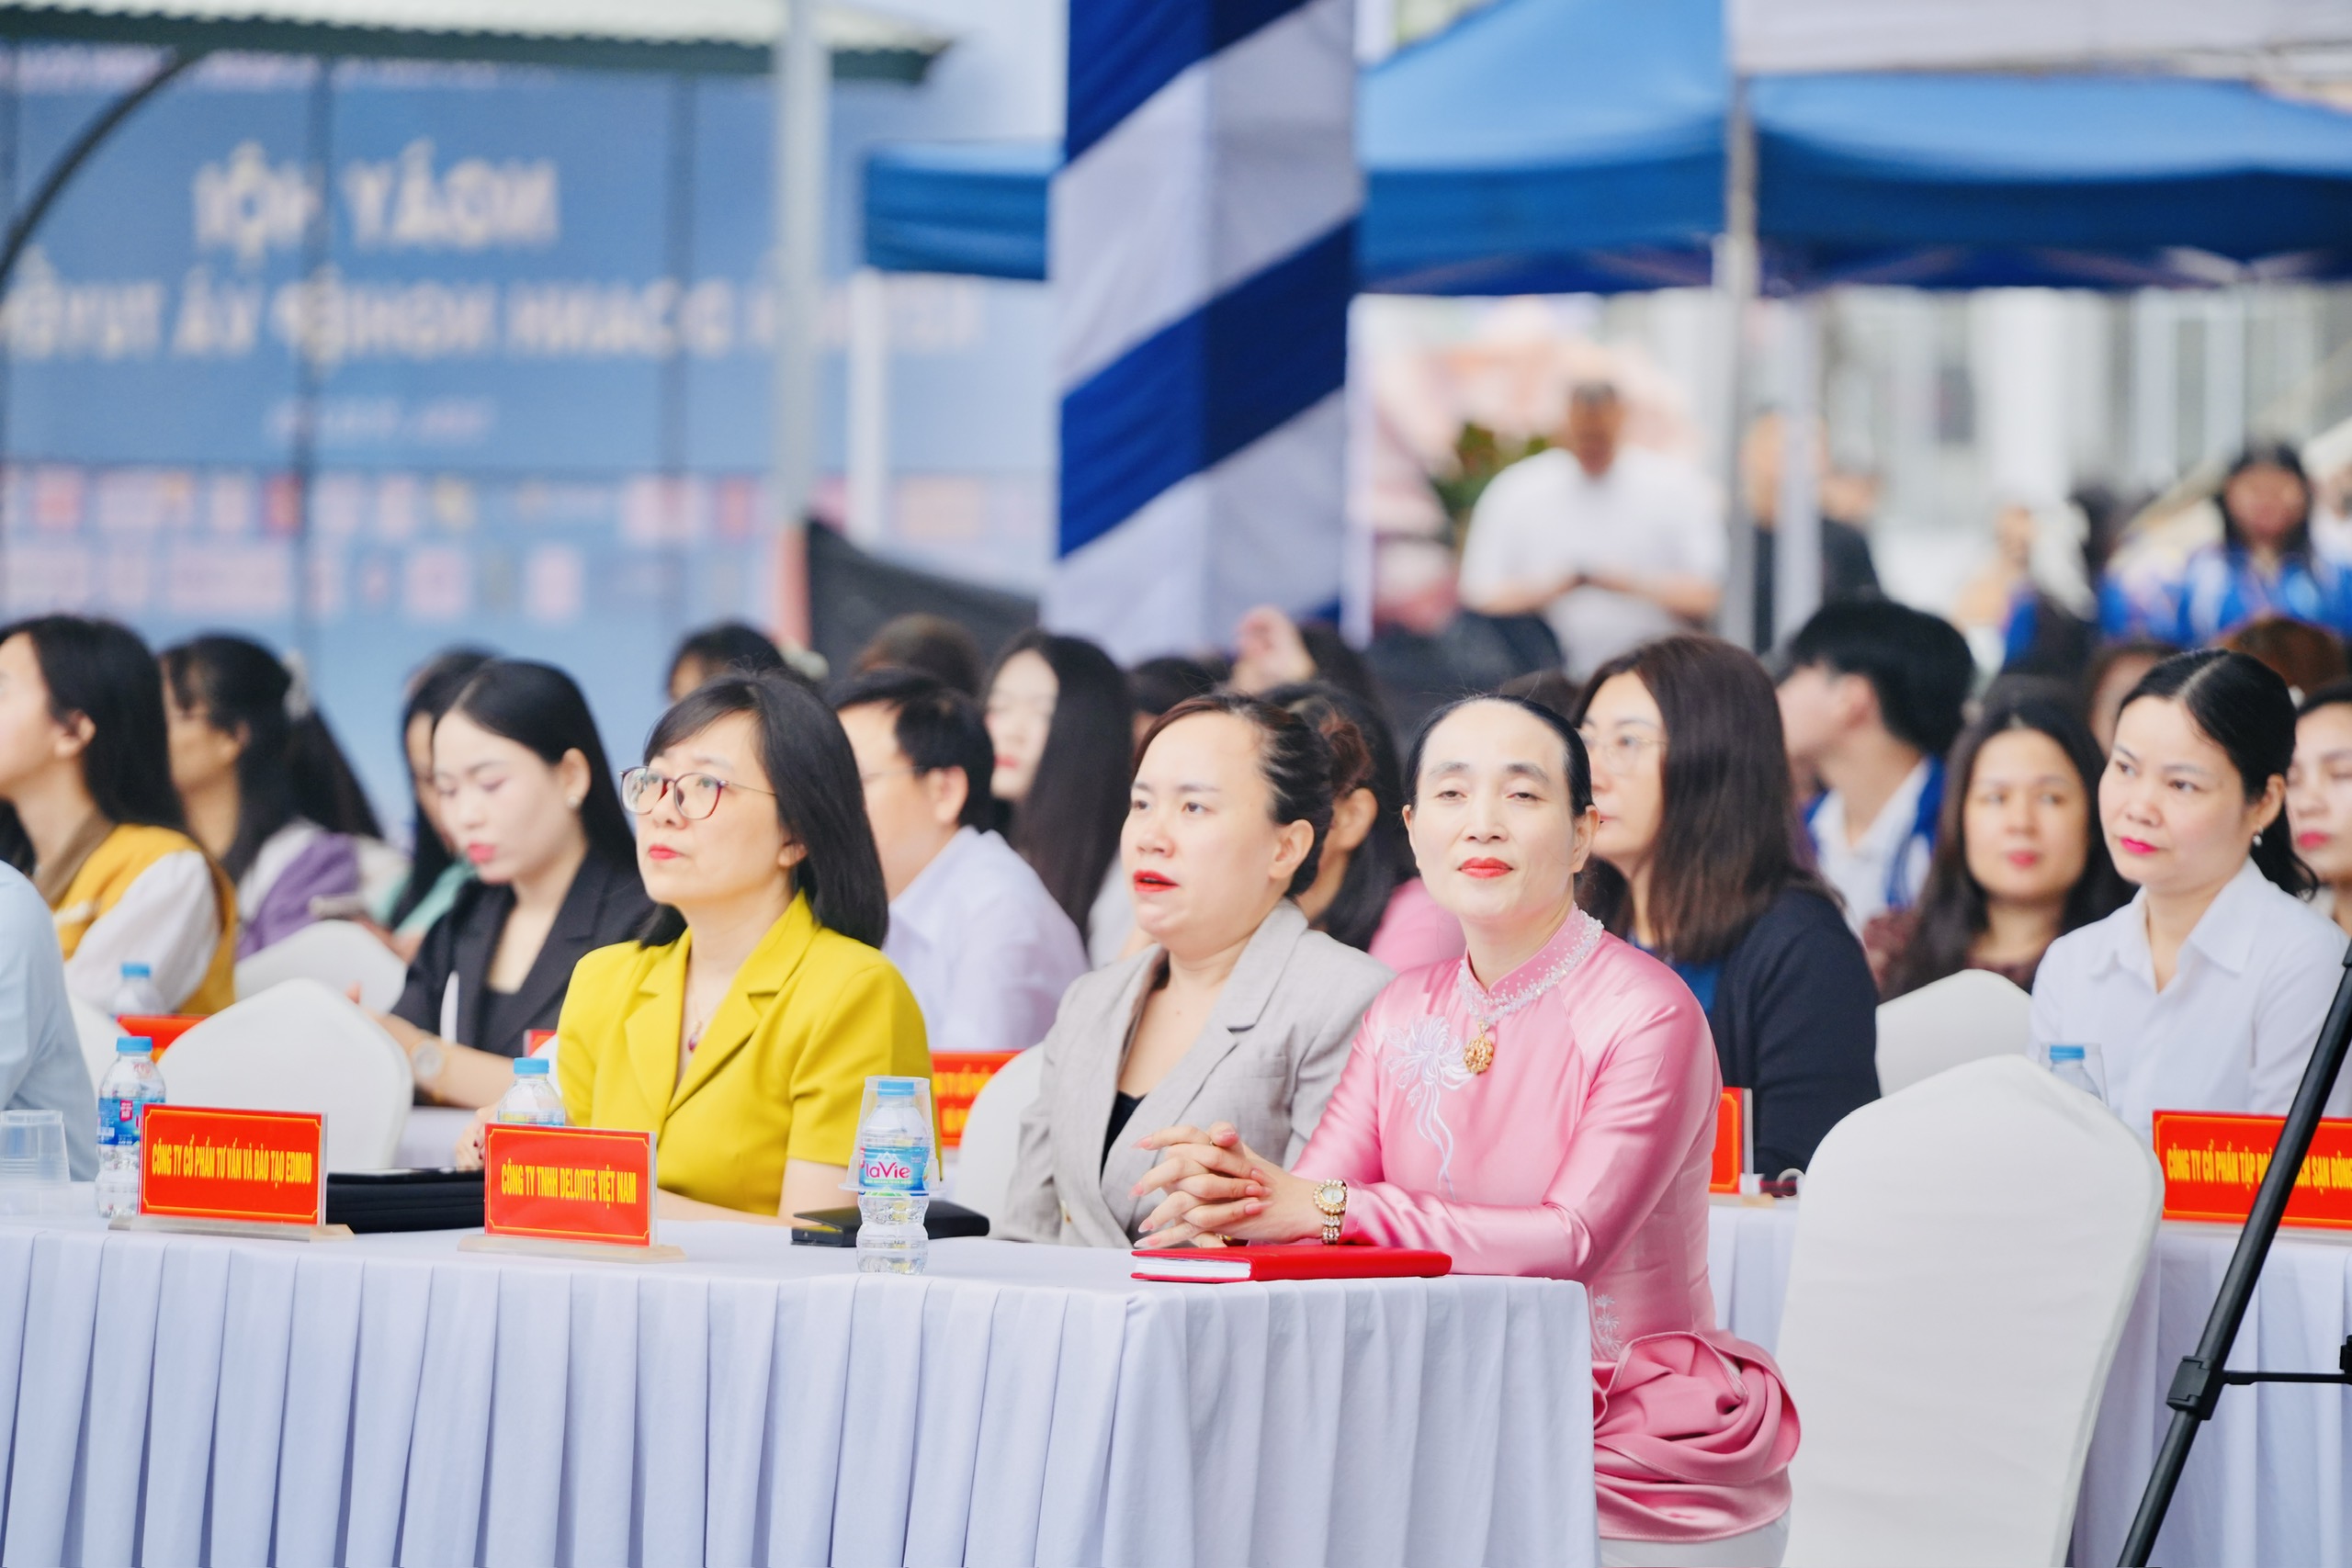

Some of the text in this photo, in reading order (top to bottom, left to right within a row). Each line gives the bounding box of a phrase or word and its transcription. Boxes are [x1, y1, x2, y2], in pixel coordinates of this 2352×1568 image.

[153, 1138, 172, 1176] CÔNG
[174, 1145, 182, 1176] TY
[184, 1134, 195, 1177] CỔ
[195, 1136, 215, 1178] PHẦN
[217, 1145, 227, 1179] TƯ
[227, 1138, 242, 1180] VẤN
[243, 1143, 253, 1180] VÀ
[254, 1144, 269, 1181] ĐÀO
[271, 1150, 284, 1189] TẠO
[502, 1157, 637, 1210] CÔNG TY TNHH DELOITTE VIỆT NAM
[865, 1161, 911, 1179] laVie
[2166, 1142, 2190, 1181] CÔNG
[2190, 1149, 2201, 1181] TY
[2202, 1138, 2214, 1182] CỔ
[2215, 1141, 2240, 1183] PHẦN
[2240, 1145, 2256, 1191] TẬP
[2312, 1156, 2330, 1196] SẠN
